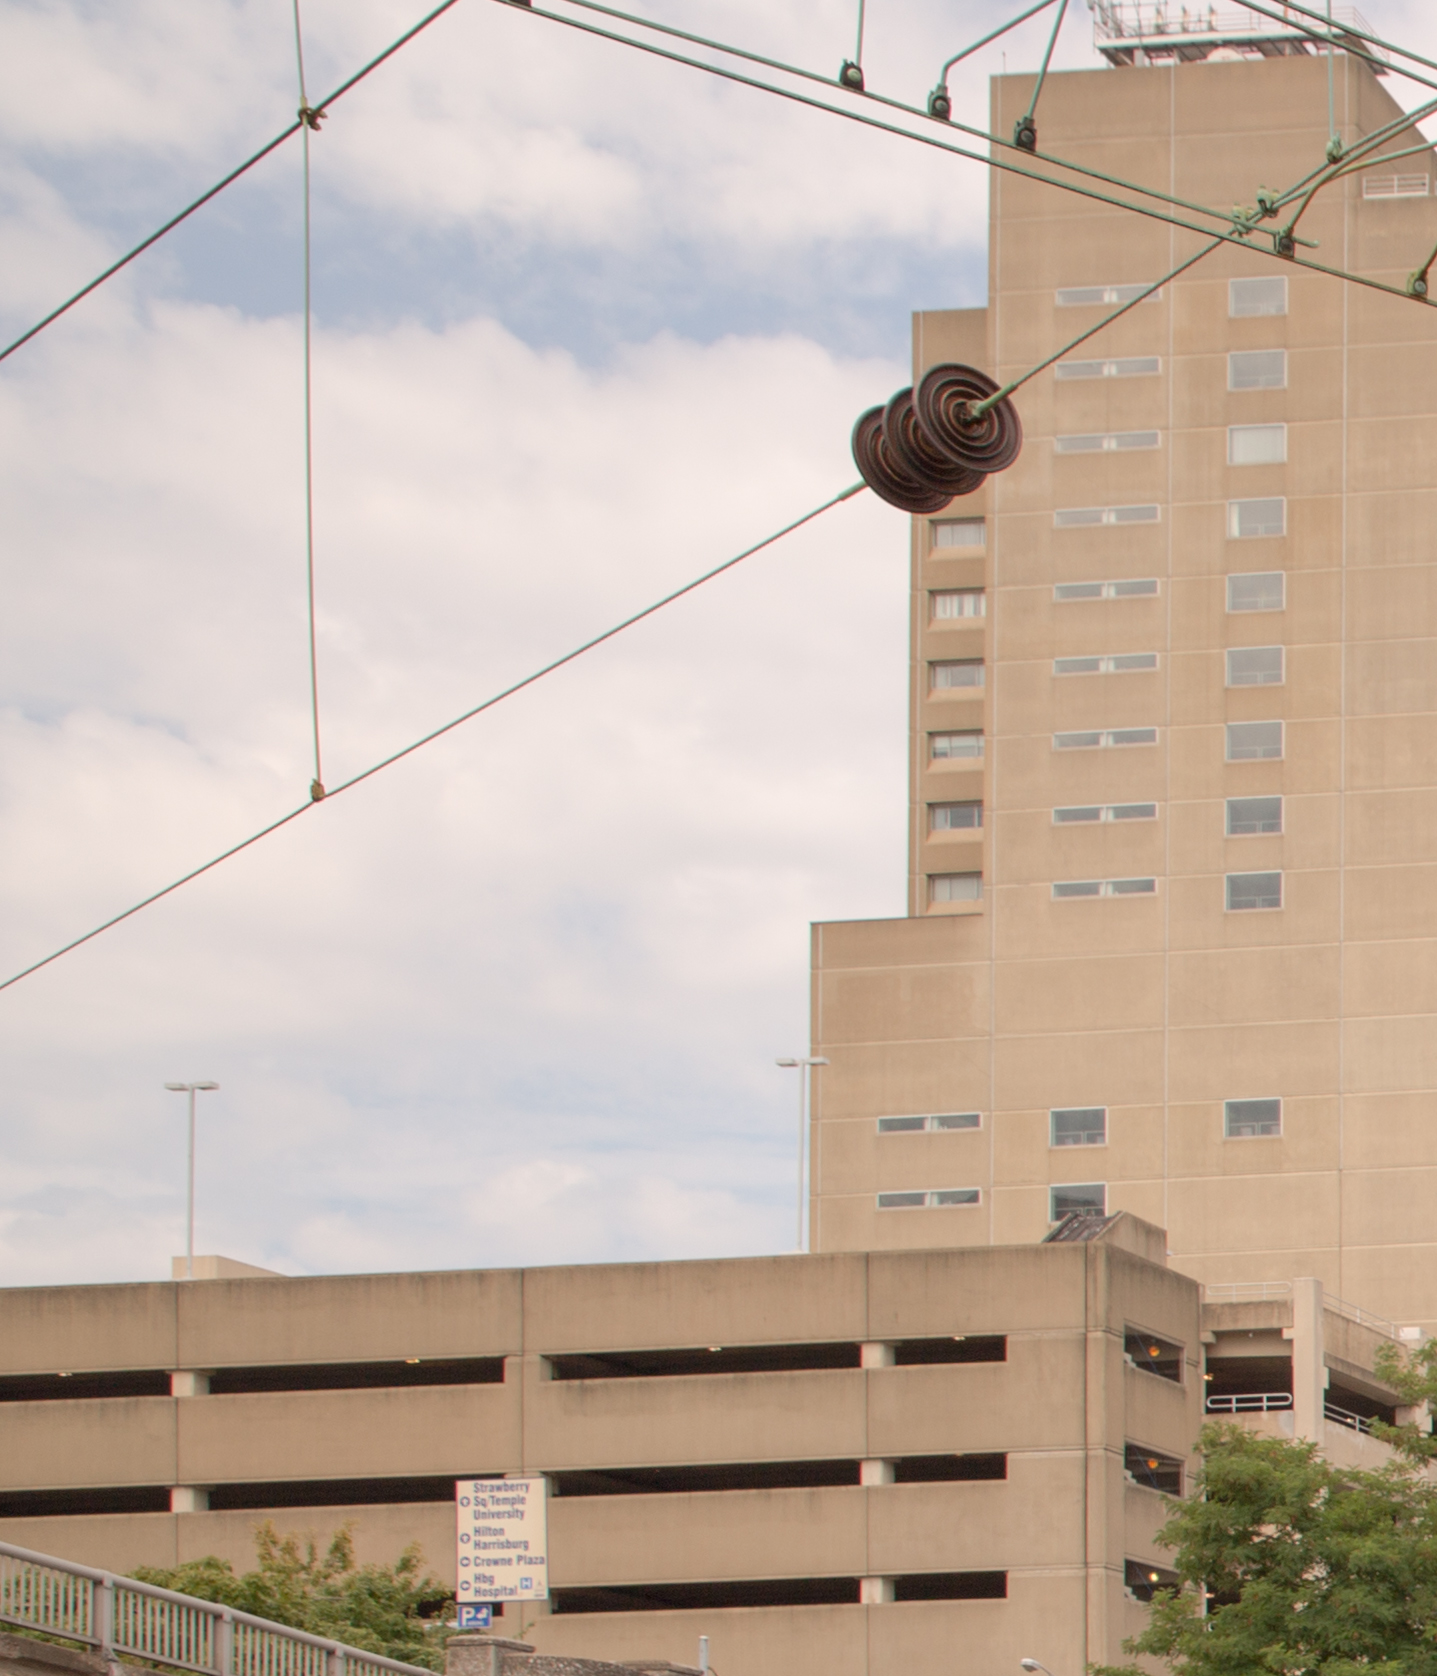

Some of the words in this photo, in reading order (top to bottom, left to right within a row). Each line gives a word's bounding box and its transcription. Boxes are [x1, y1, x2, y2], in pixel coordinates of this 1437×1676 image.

[474, 1482, 529, 1493] Strawberry
[474, 1509, 524, 1520] University
[474, 1526, 505, 1537] Hilton
[474, 1539, 529, 1551] Harrisburg
[474, 1556, 513, 1567] Crowne
[516, 1555, 545, 1565] Plaza
[474, 1573, 494, 1586] Hbg
[474, 1586, 518, 1598] Hospital
[461, 1607, 476, 1626] P
